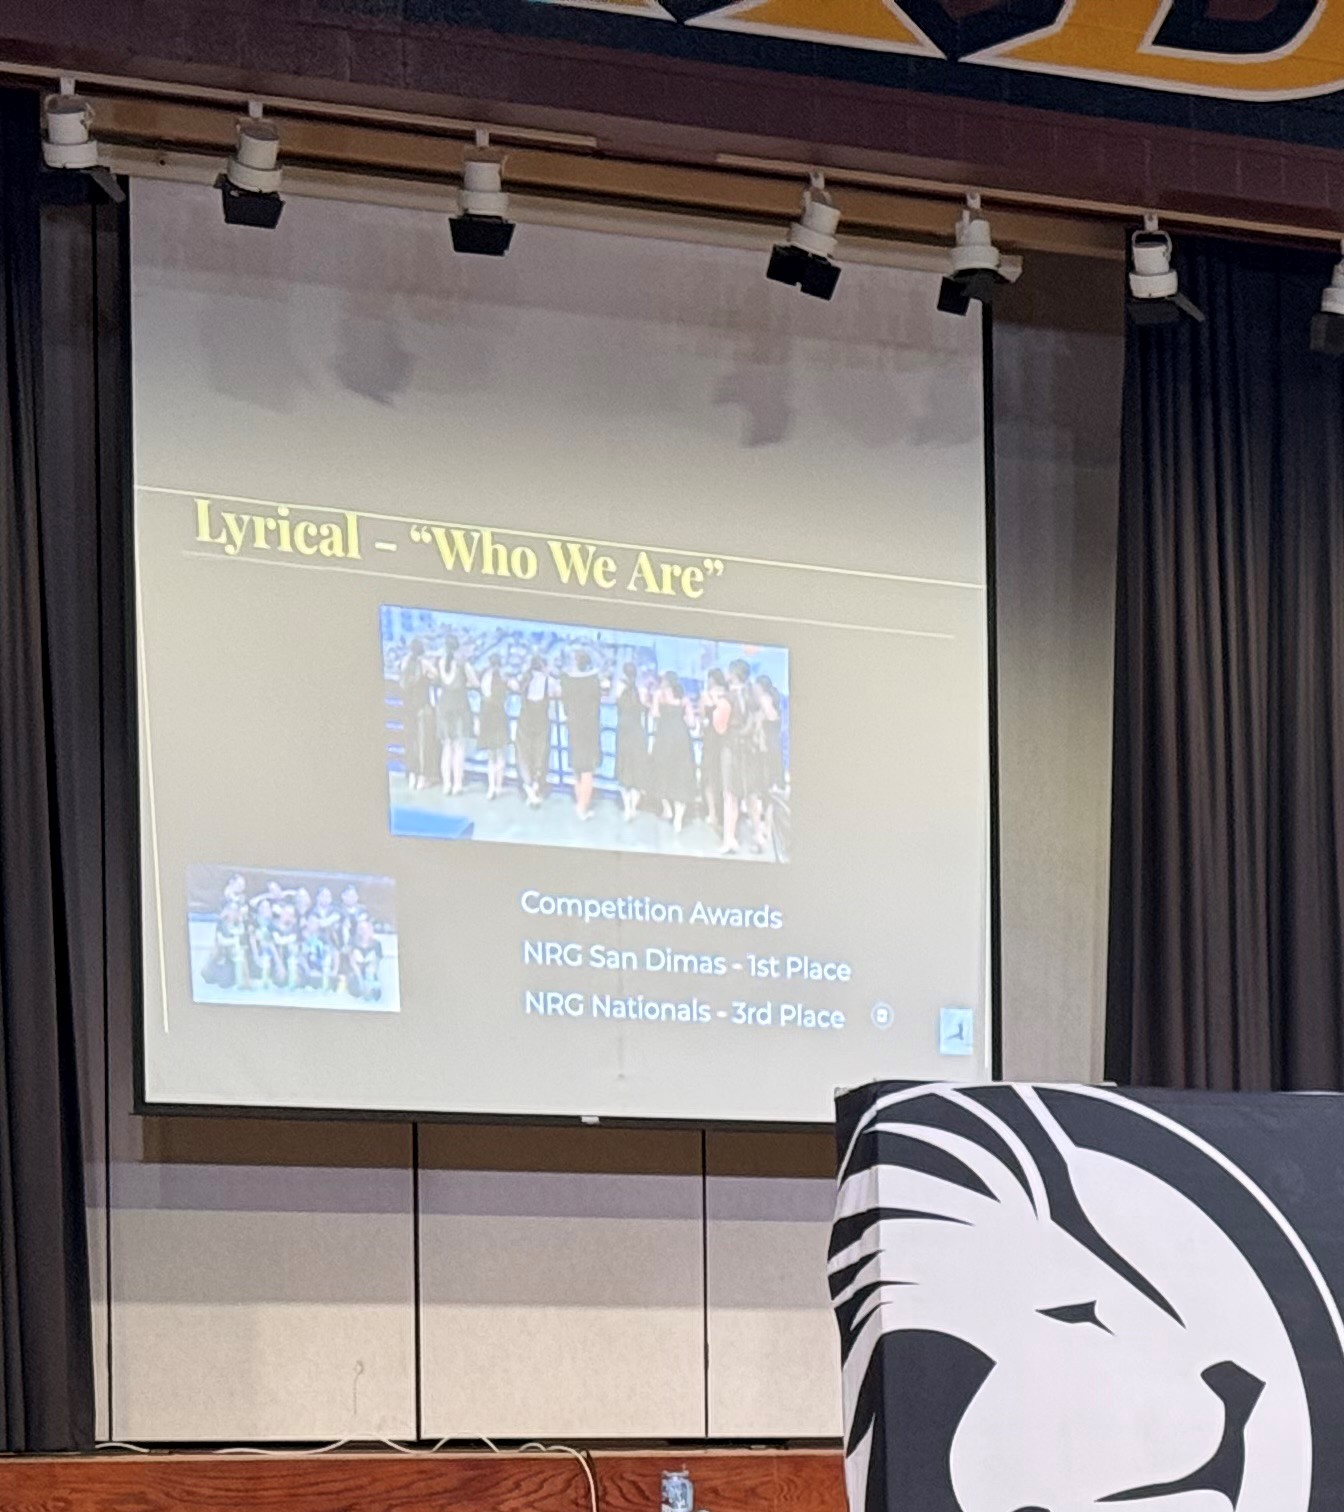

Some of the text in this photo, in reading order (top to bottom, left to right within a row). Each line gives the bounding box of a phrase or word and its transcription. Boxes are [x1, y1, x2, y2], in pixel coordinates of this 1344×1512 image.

[195, 498, 361, 558] Lyrical
[548, 540, 617, 588] We
[521, 890, 784, 929] Competition Awards
[523, 940, 583, 967] NRG
[589, 944, 638, 971] San
[645, 946, 727, 975] Dimas
[748, 954, 780, 978] 1st
[786, 956, 852, 982] Place
[524, 991, 584, 1017] NRG
[592, 994, 712, 1024] Nationals
[731, 1001, 773, 1026] 3rd
[779, 1004, 846, 1029] Place
